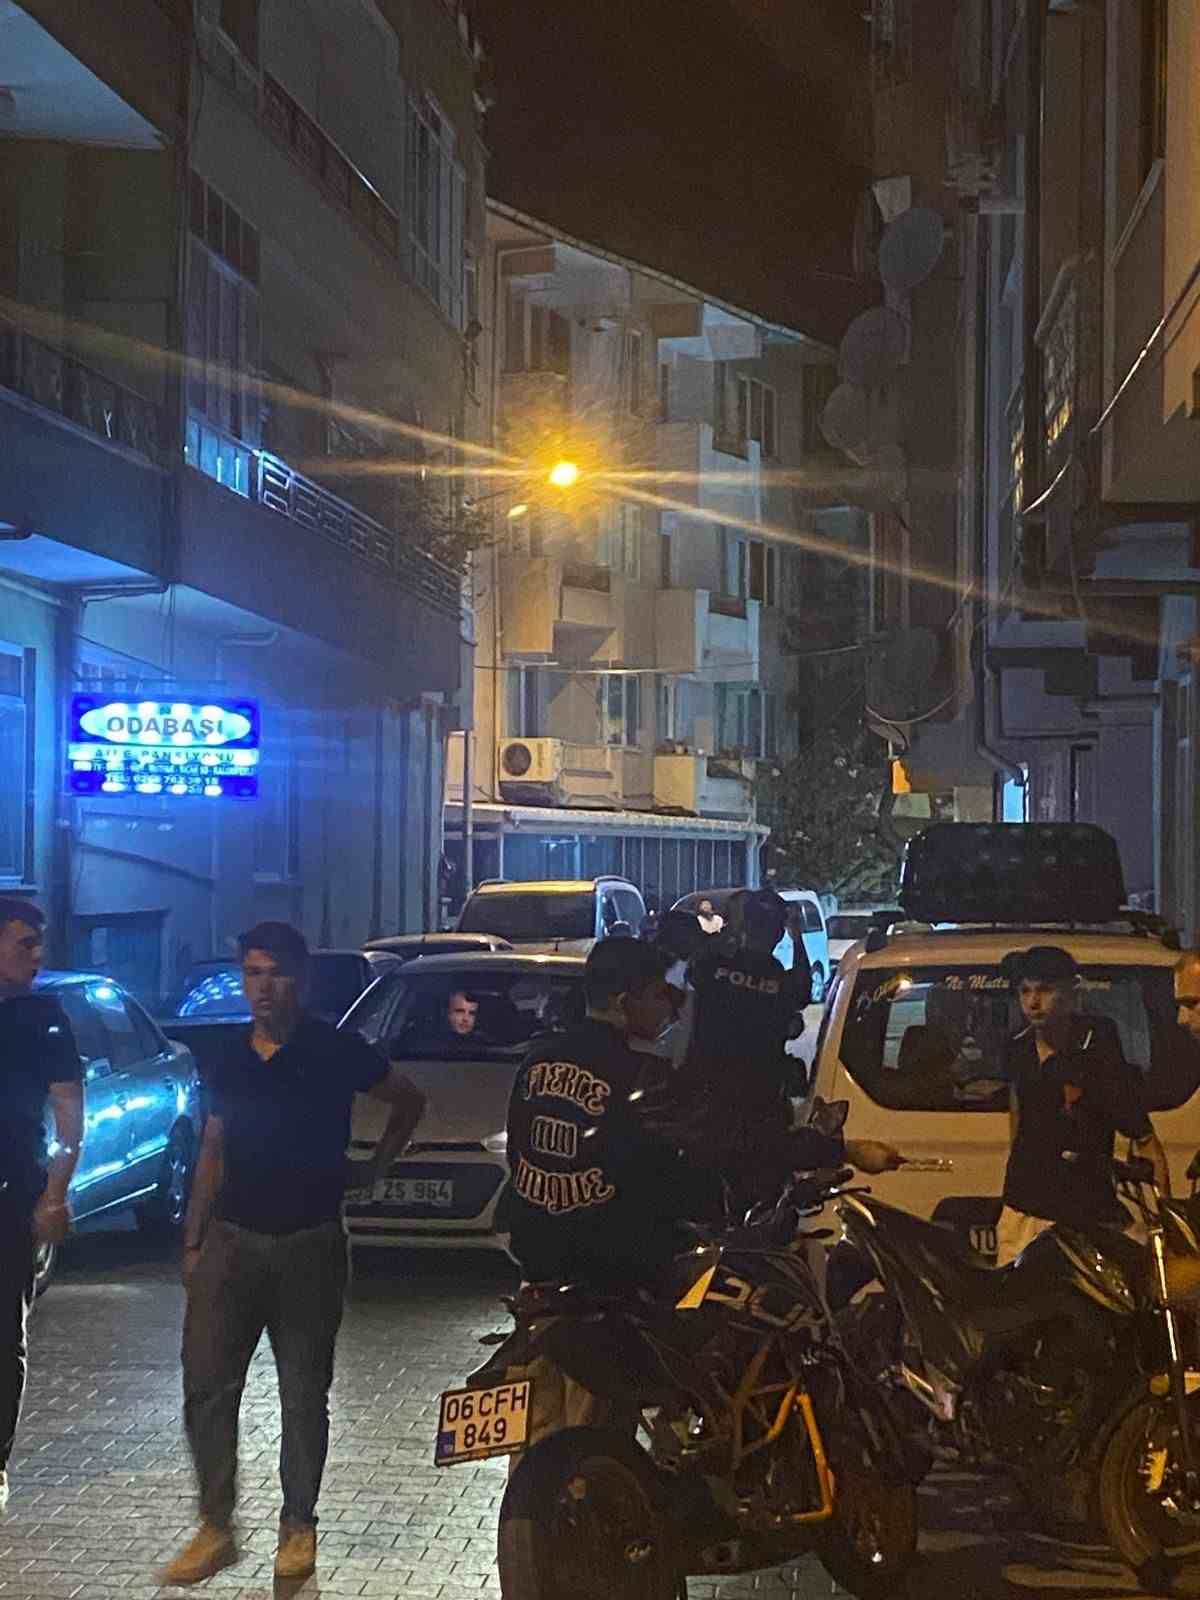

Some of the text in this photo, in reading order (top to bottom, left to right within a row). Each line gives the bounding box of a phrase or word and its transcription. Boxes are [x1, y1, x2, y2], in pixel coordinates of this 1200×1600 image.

[107, 716, 224, 740] ODABAŞI
[446, 1385, 527, 1423] 06 CFH
[463, 1418, 507, 1449] 849
